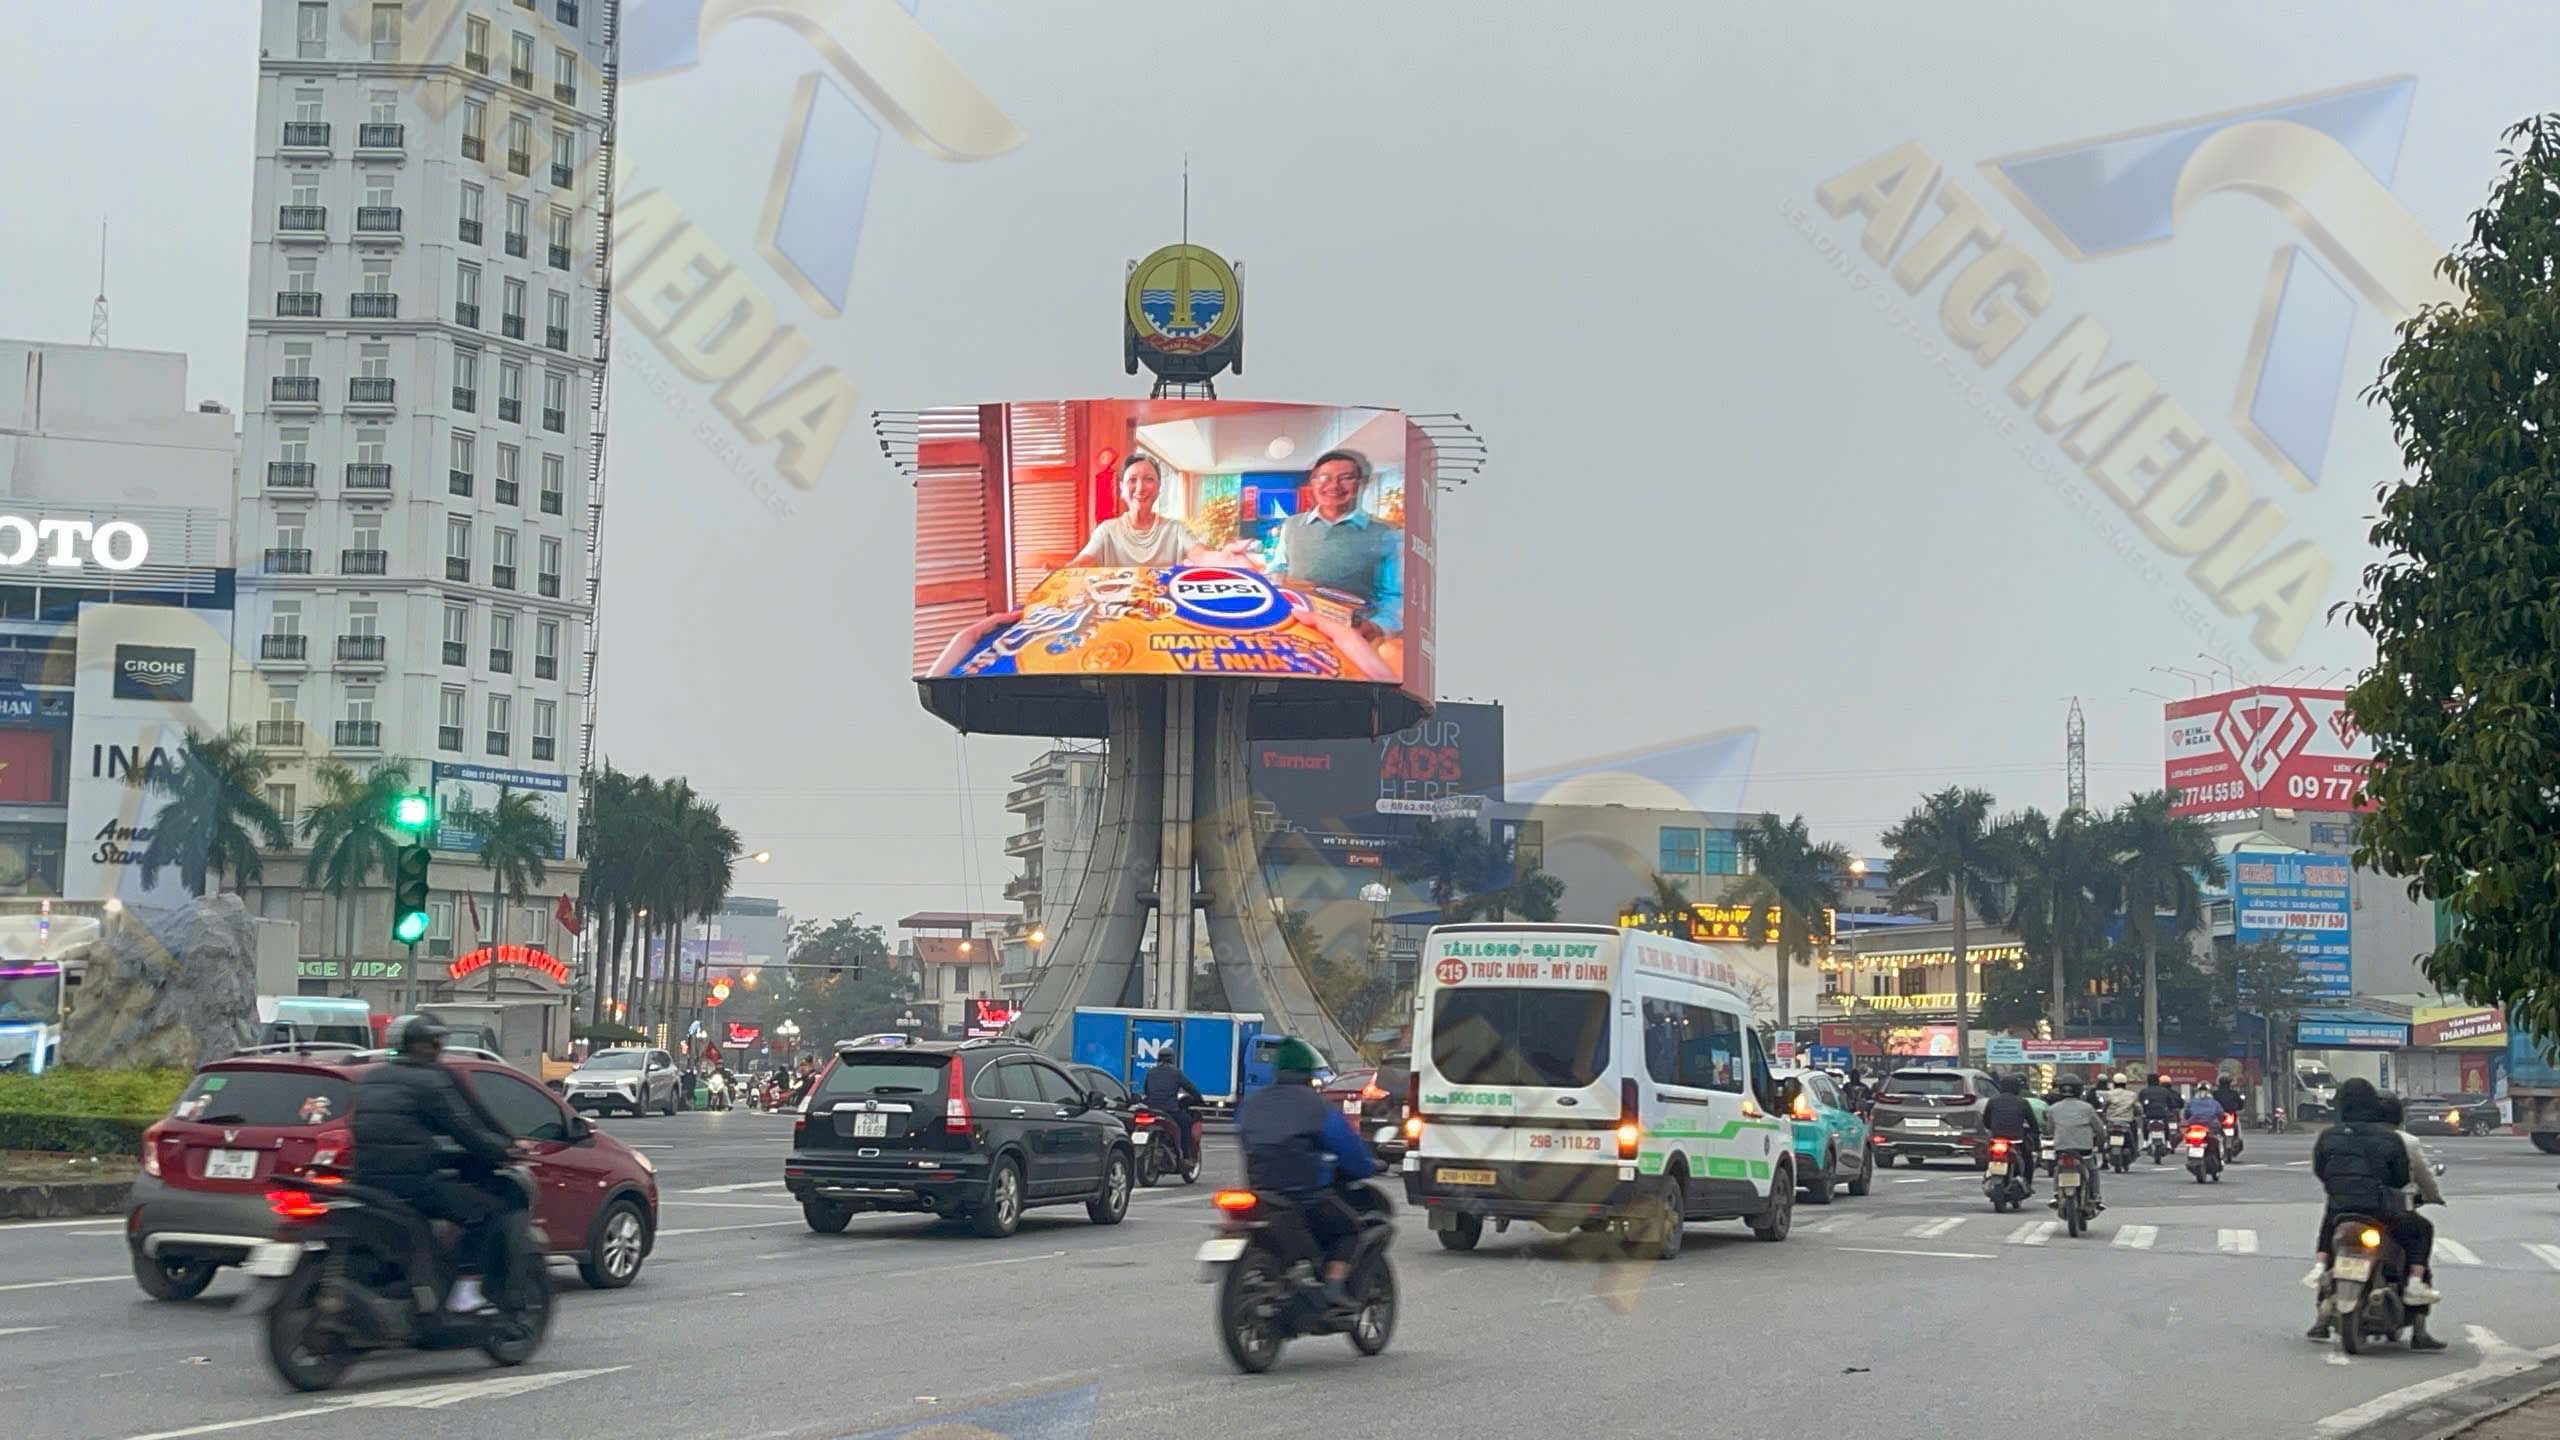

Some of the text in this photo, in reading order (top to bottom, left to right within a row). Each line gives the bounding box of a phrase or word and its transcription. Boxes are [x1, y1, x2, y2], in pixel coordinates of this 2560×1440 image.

[1177, 583, 1264, 595] PEPSI
[1151, 634, 1235, 650] MANG
[124, 659, 186, 675] GROHE
[92, 743, 187, 779] INA
[1380, 746, 1462, 781] ADS
[2288, 774, 2320, 800] 09
[2323, 776, 2353, 801] 77
[1443, 940, 1475, 957] TÂN
[1563, 944, 1598, 958] DUY
[1438, 964, 1464, 981] 215
[1551, 960, 1572, 980] MỸ
[2476, 1021, 2502, 1036] NAM
